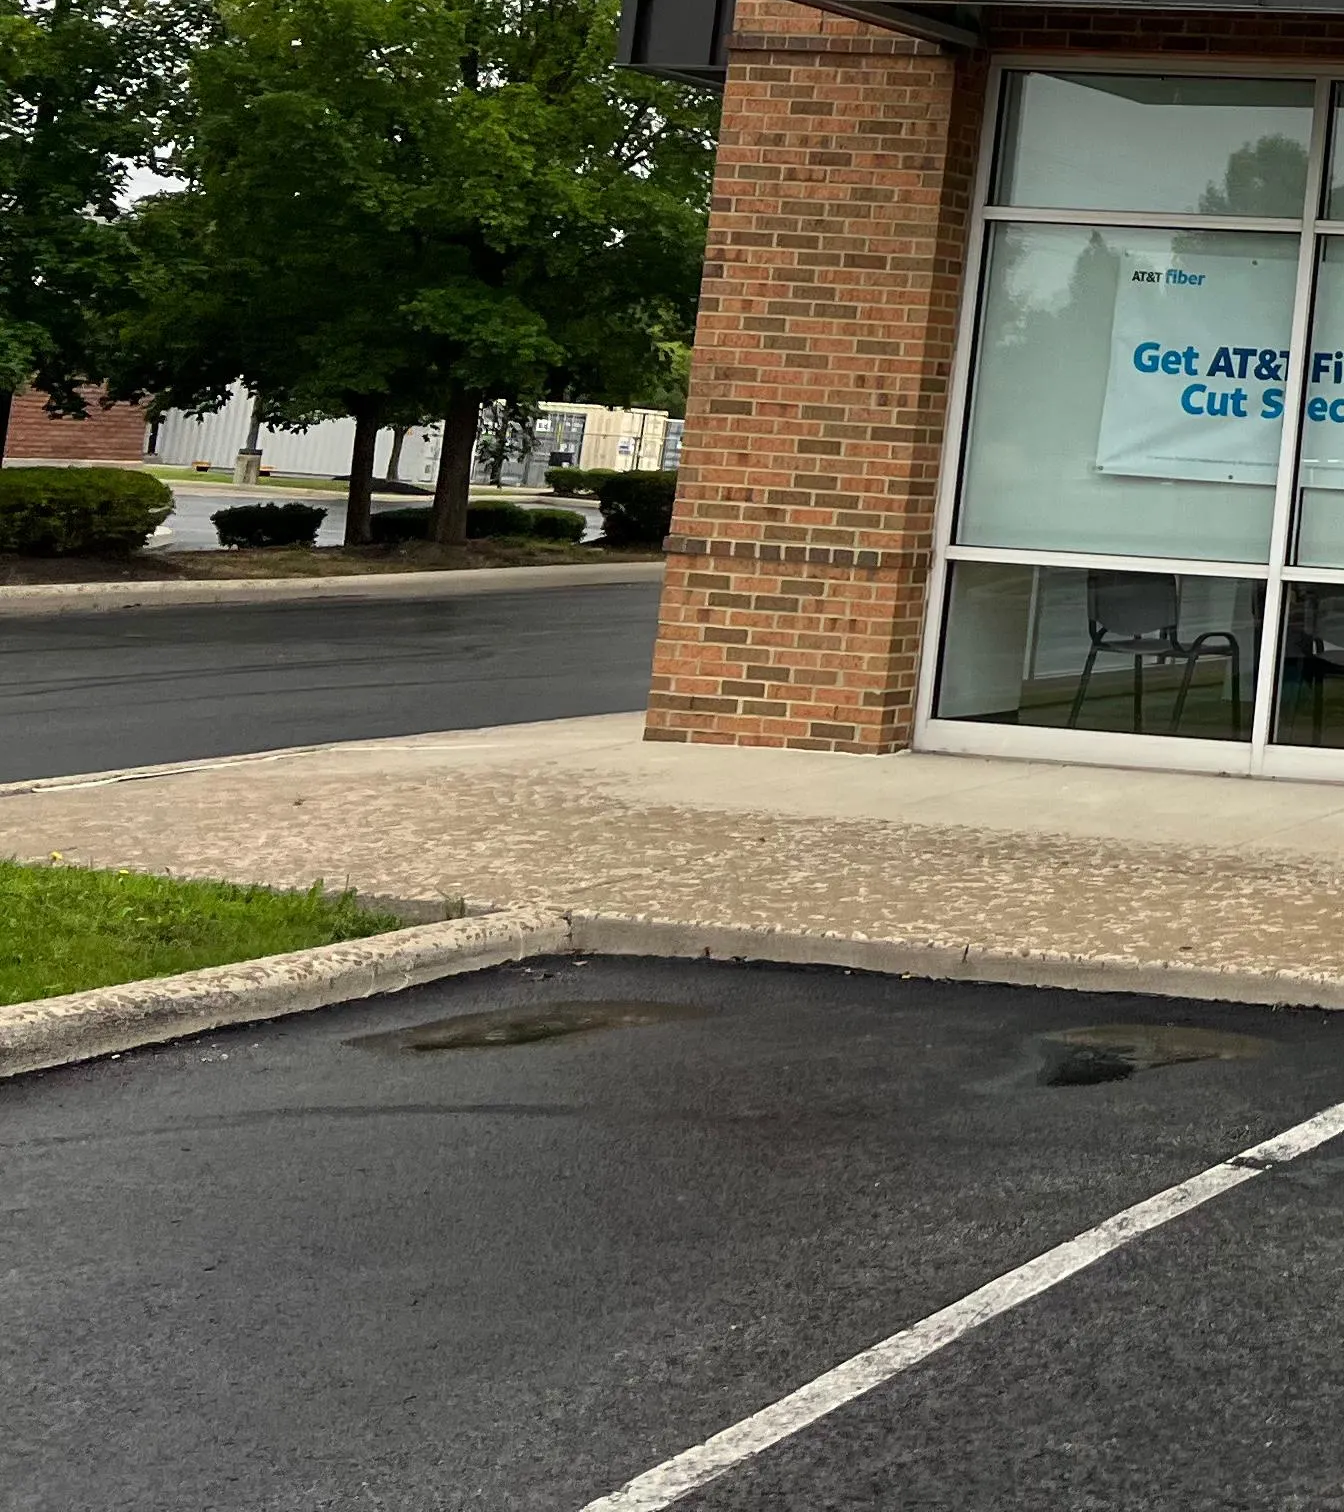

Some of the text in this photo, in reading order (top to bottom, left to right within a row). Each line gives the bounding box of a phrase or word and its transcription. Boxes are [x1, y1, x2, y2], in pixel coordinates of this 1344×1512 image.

[1132, 268, 1206, 286] AT&T fiber
[1133, 341, 1199, 376] Get
[1181, 383, 1248, 418] Cut
